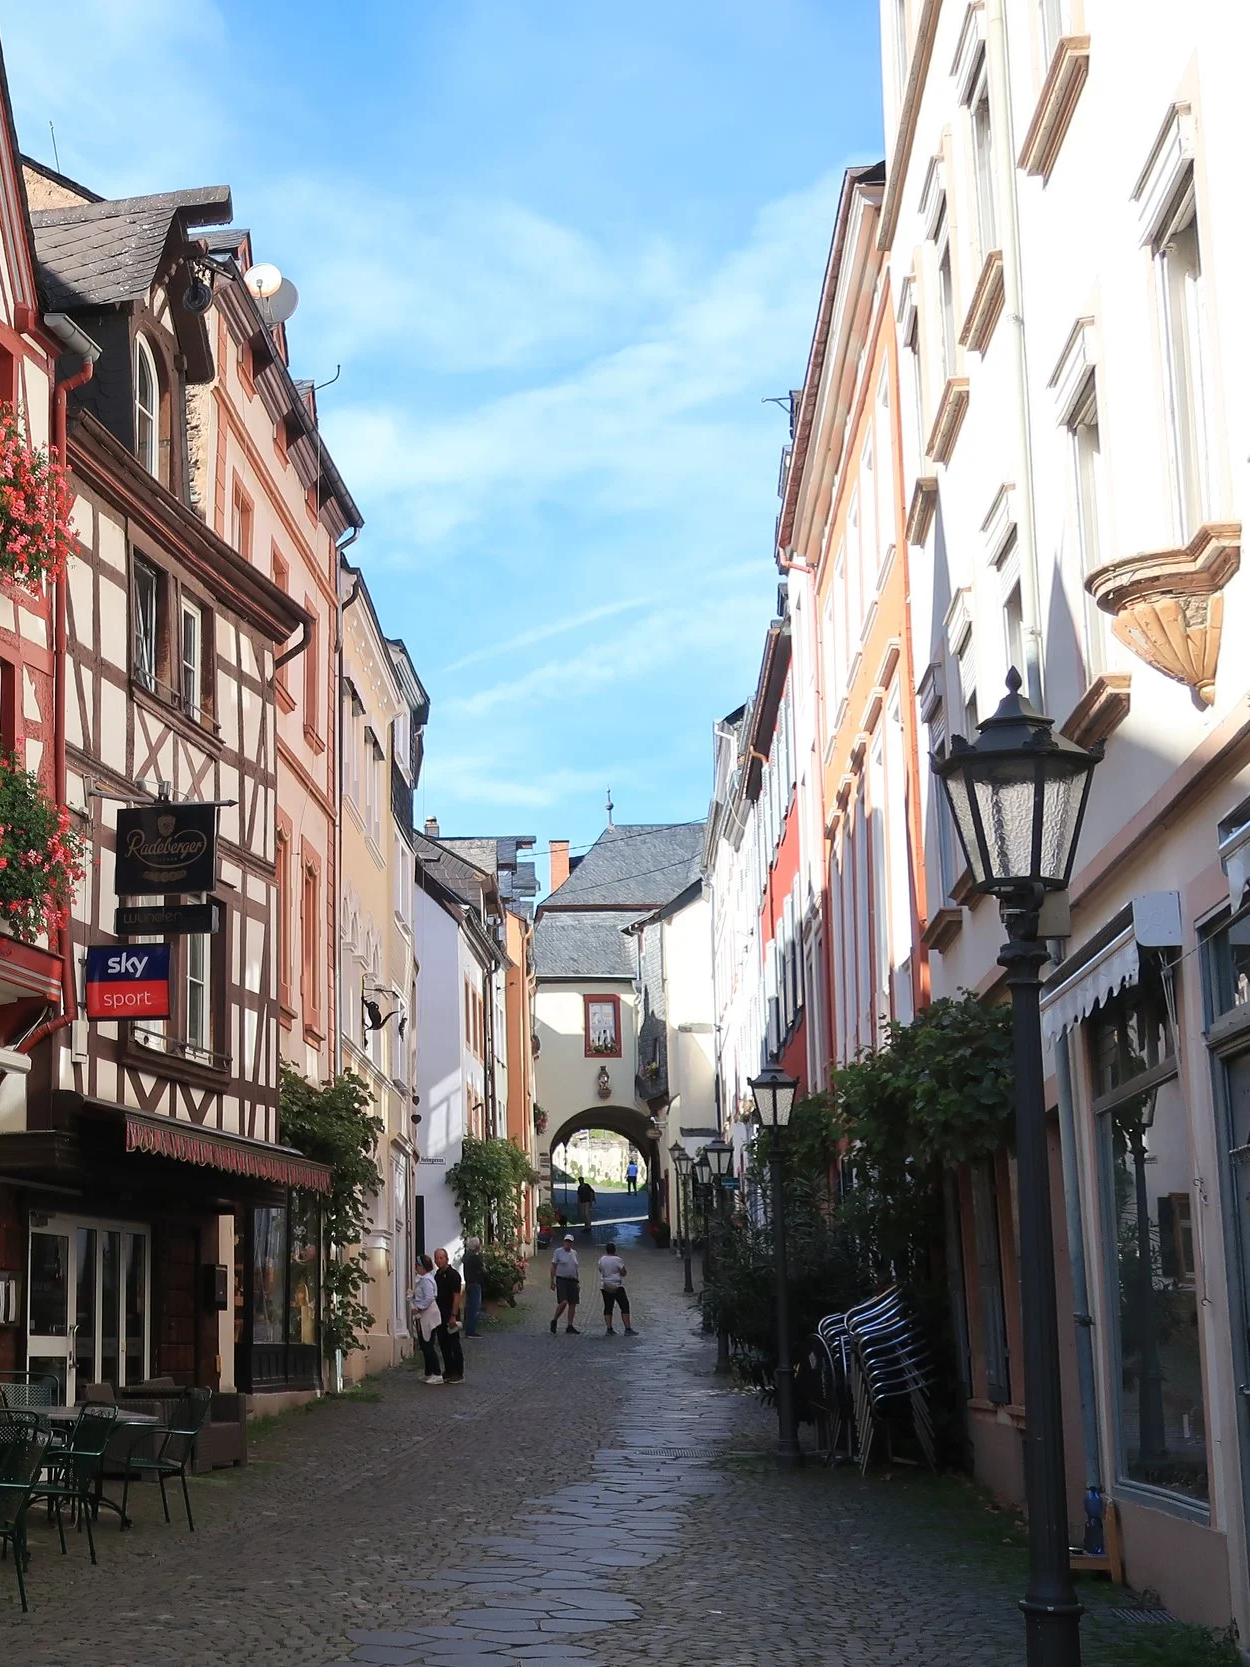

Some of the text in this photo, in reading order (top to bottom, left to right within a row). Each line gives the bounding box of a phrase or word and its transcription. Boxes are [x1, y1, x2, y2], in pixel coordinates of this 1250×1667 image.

[125, 829, 205, 861] Radeberger
[107, 951, 149, 978] sky
[103, 990, 152, 1009] sport
